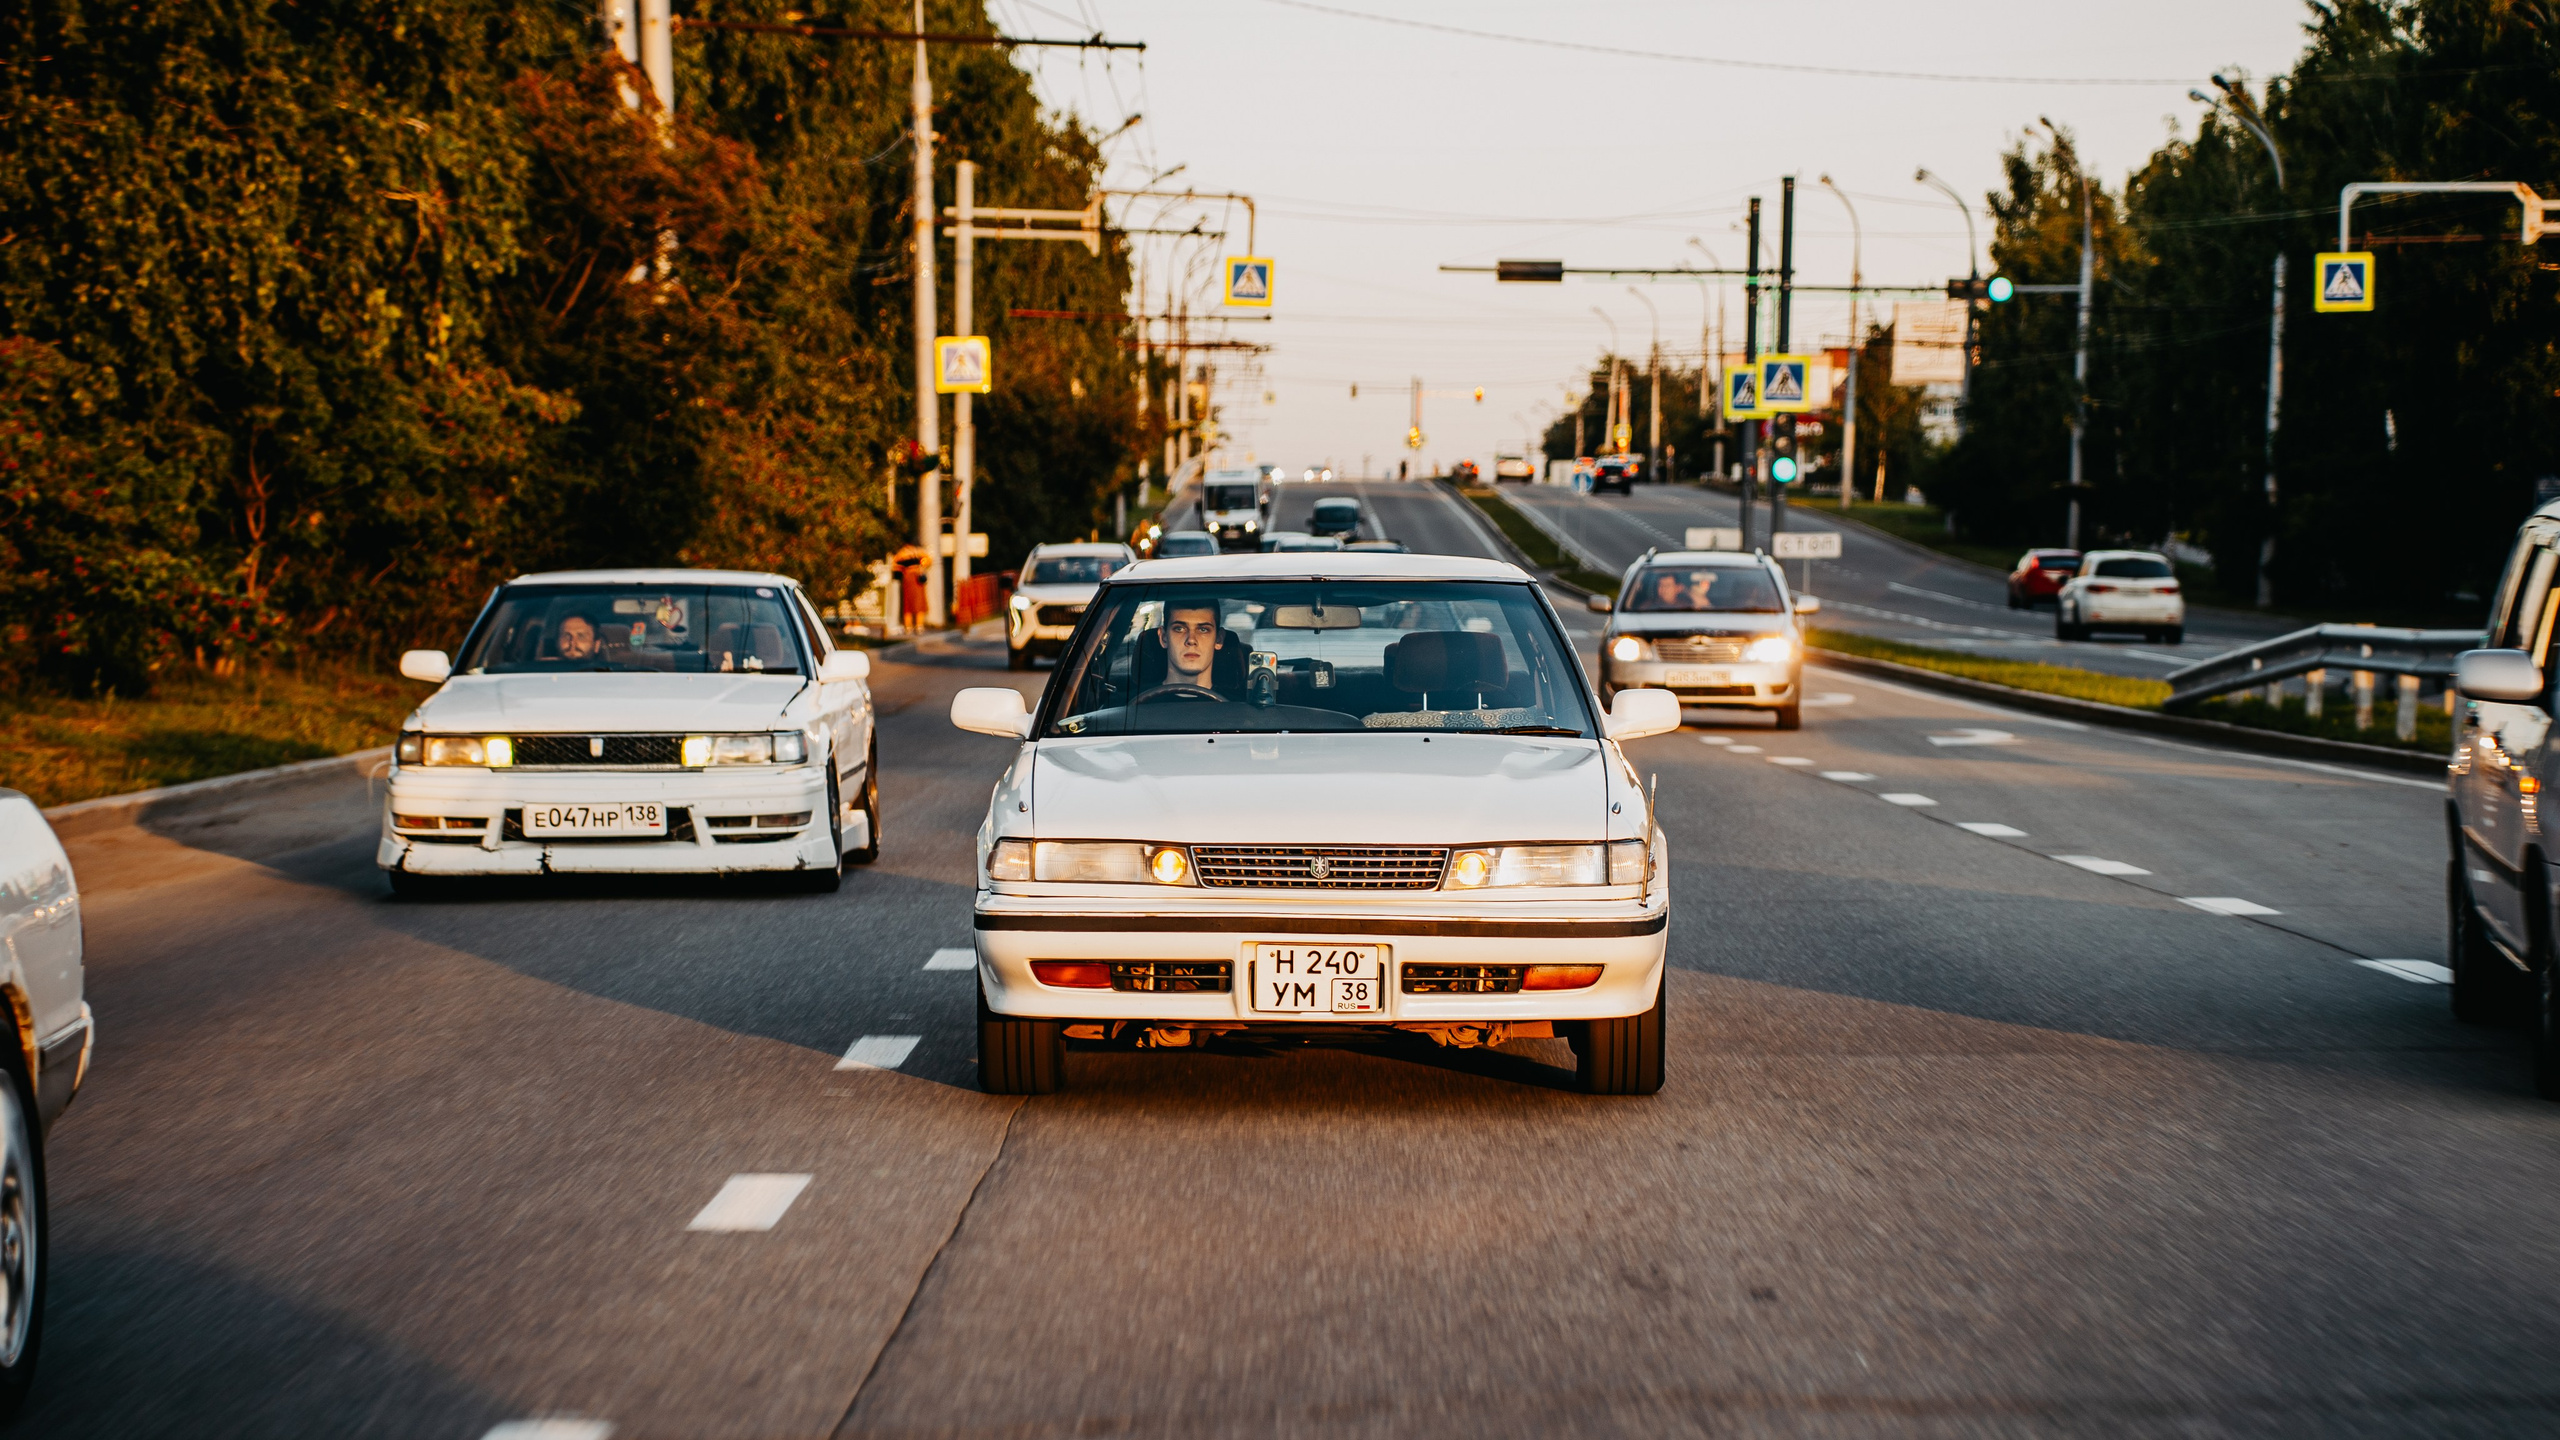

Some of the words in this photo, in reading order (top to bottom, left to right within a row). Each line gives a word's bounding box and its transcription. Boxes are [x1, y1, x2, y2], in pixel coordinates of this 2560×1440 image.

[625, 805, 657, 821] 138
[1306, 950, 1359, 975] 240
[1272, 982, 1316, 1007] УМ
[1341, 982, 1368, 1001] 38
[1337, 1002, 1356, 1010] RUS
